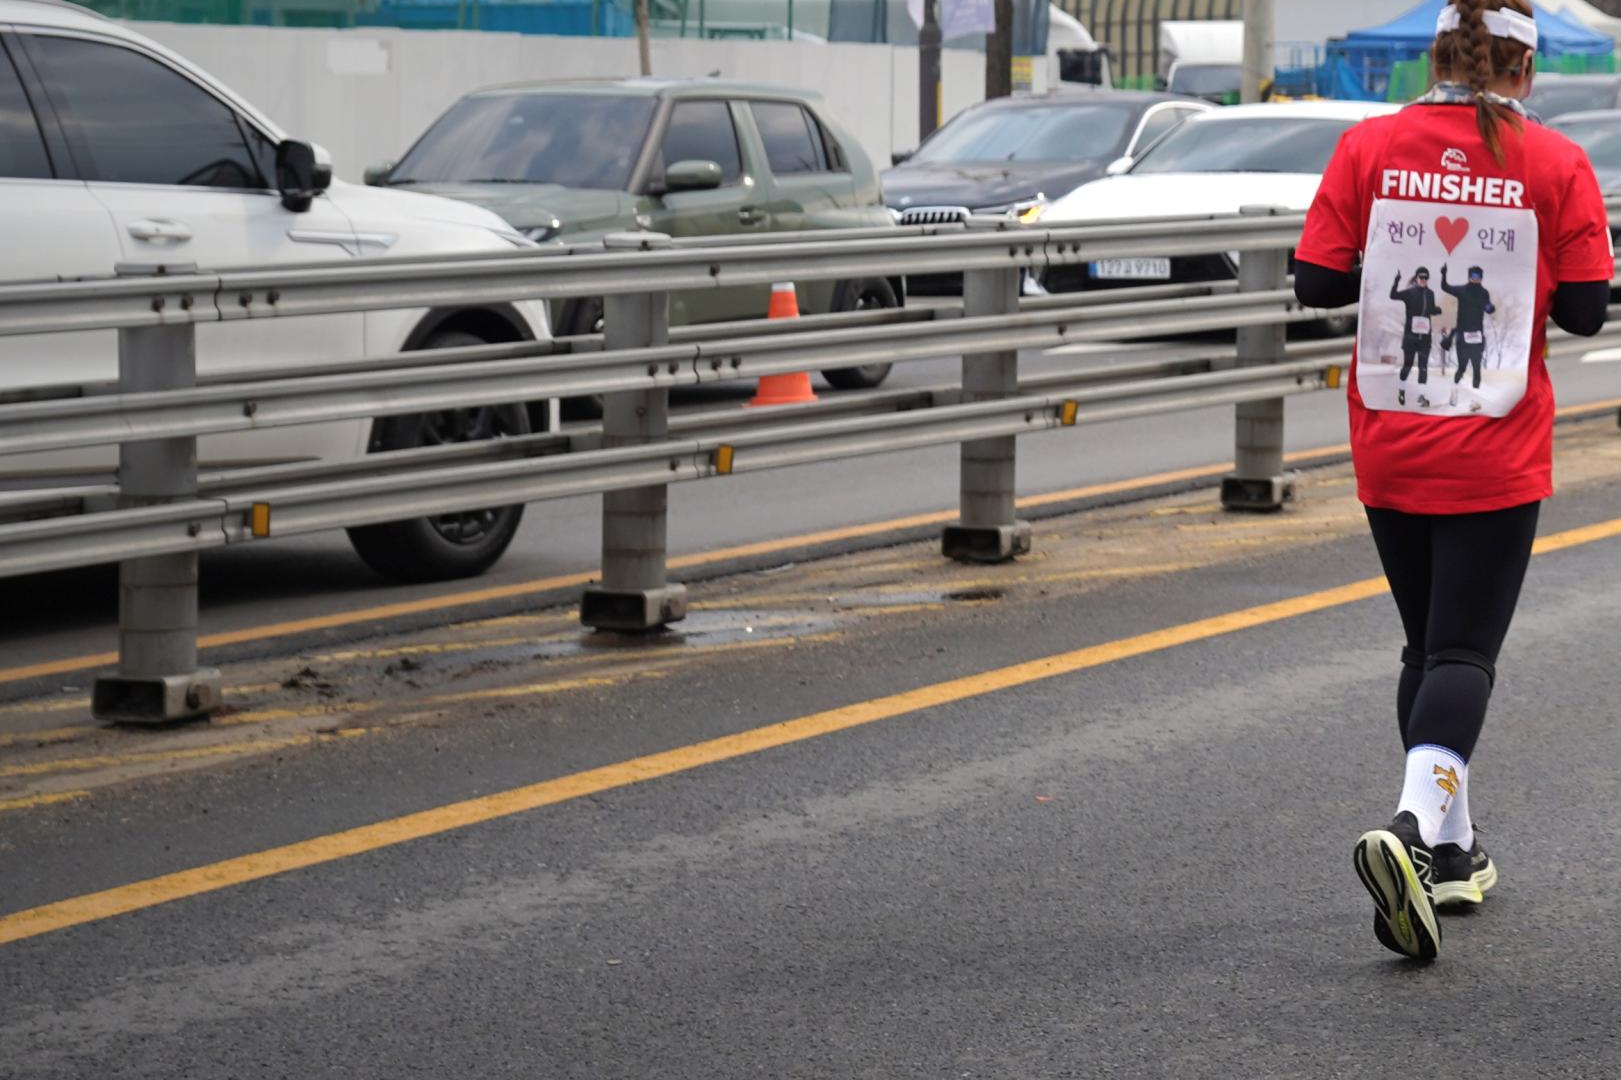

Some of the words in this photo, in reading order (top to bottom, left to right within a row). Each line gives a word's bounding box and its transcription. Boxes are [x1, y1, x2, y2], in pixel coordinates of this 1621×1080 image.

[1381, 169, 1524, 207] FINISHER
[1387, 220, 1425, 246] 현아
[1477, 228, 1515, 252] 인재
